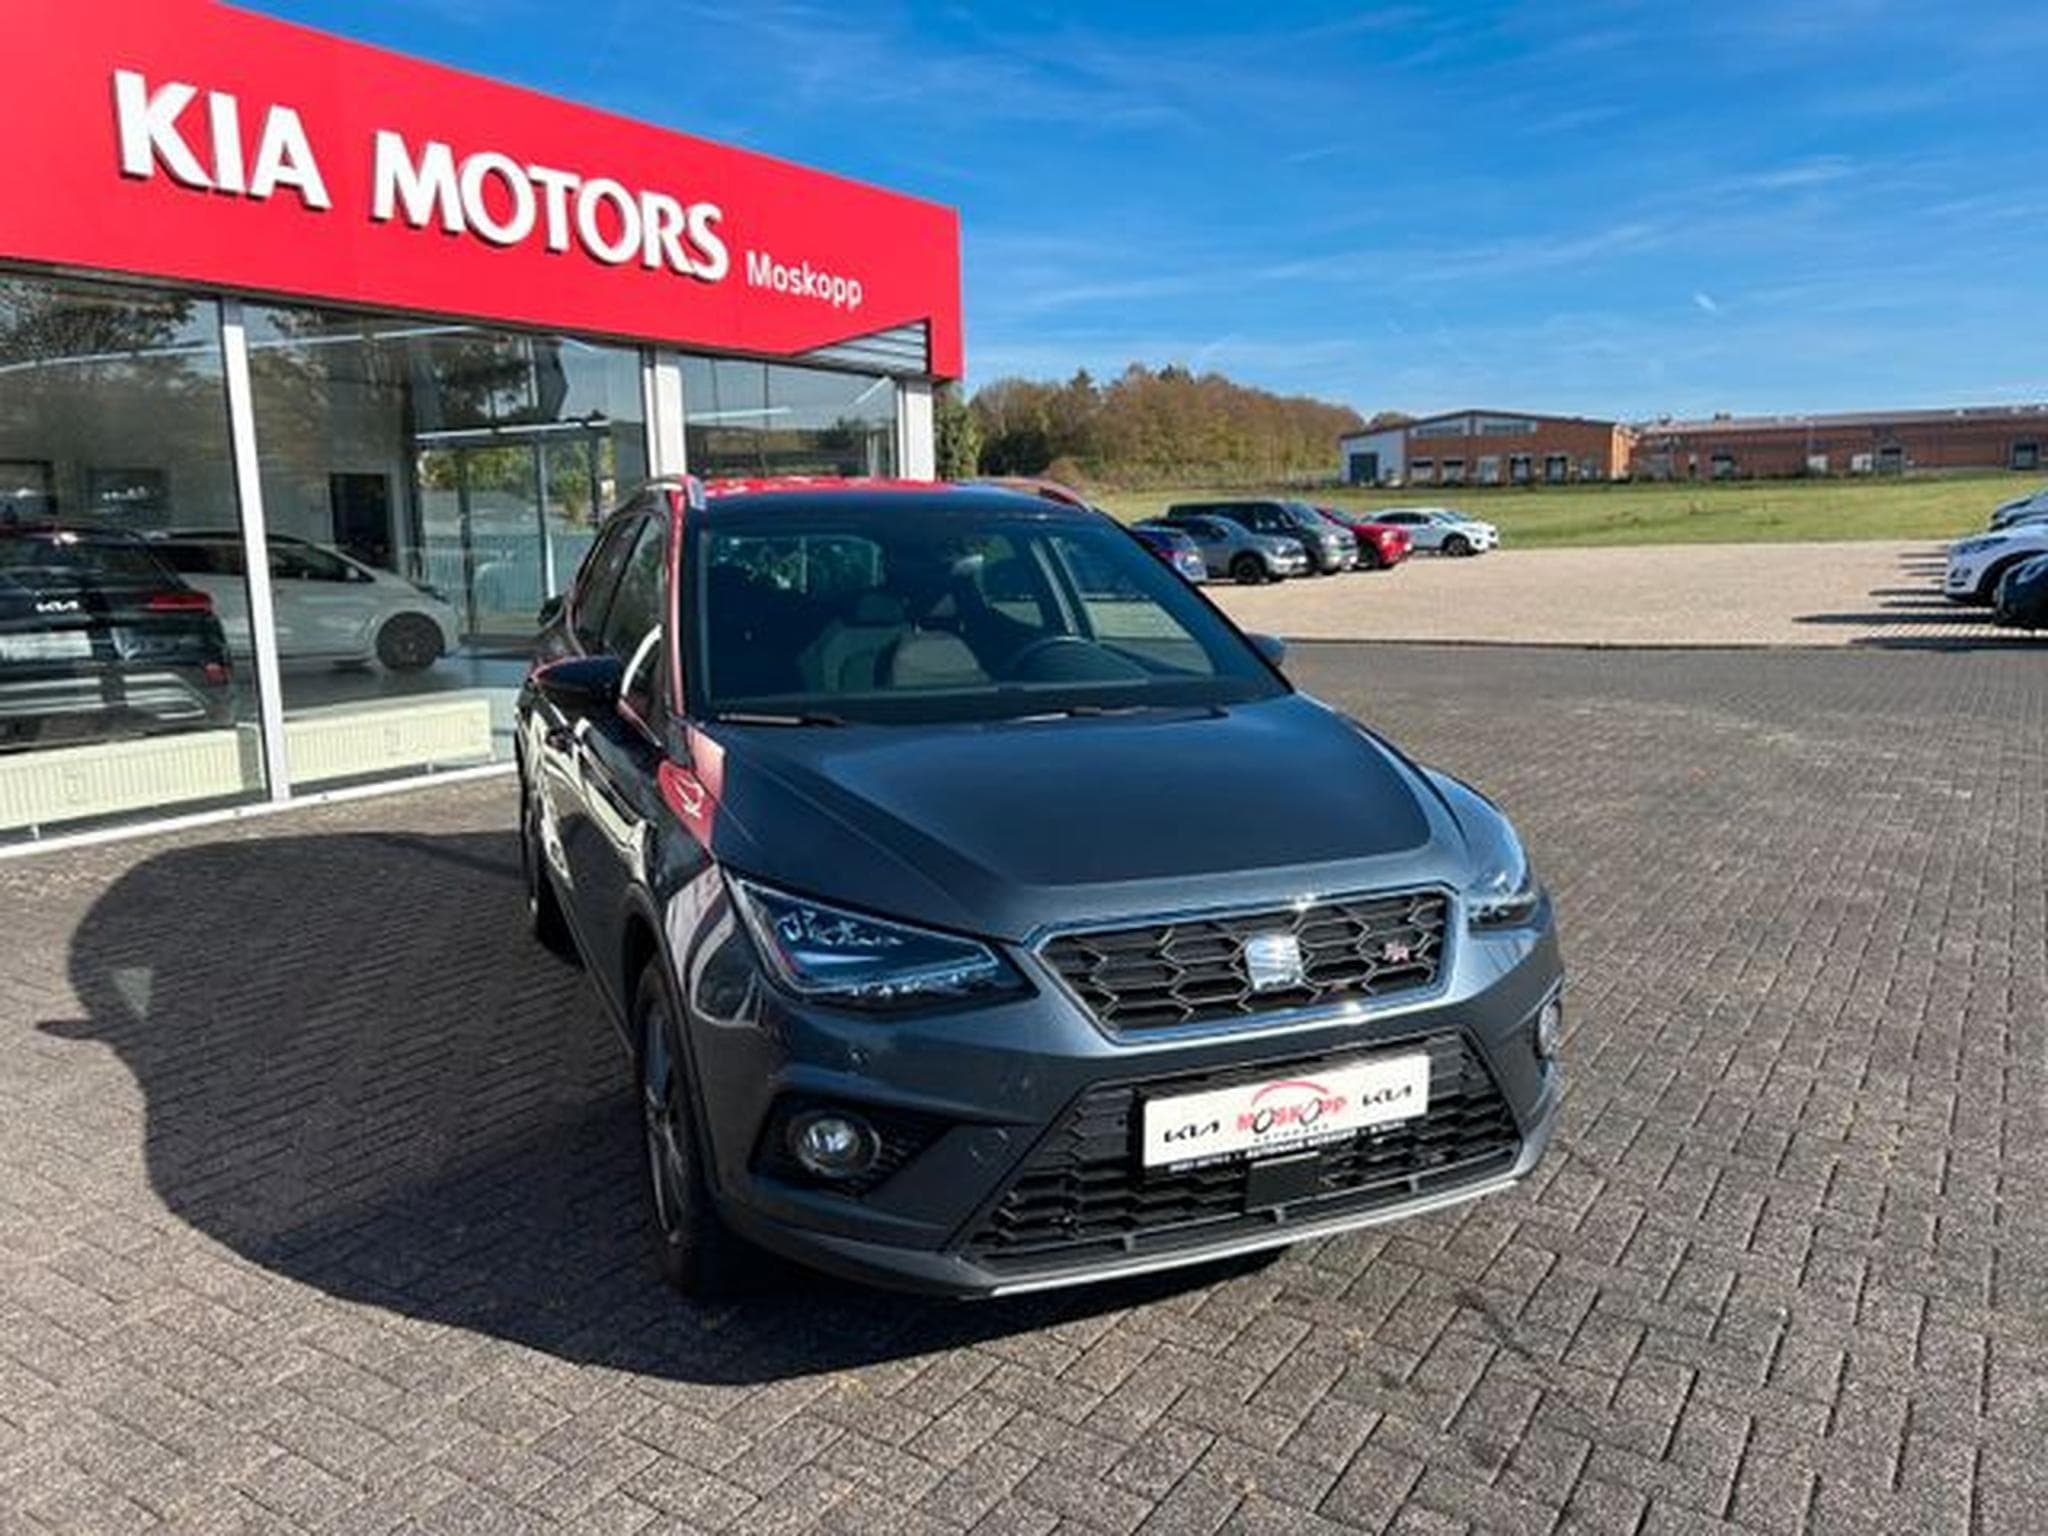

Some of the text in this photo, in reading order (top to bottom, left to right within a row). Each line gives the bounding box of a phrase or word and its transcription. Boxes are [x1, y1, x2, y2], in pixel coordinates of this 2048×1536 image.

[113, 69, 729, 282] KIA MOTORS
[746, 250, 863, 309] Moskopp
